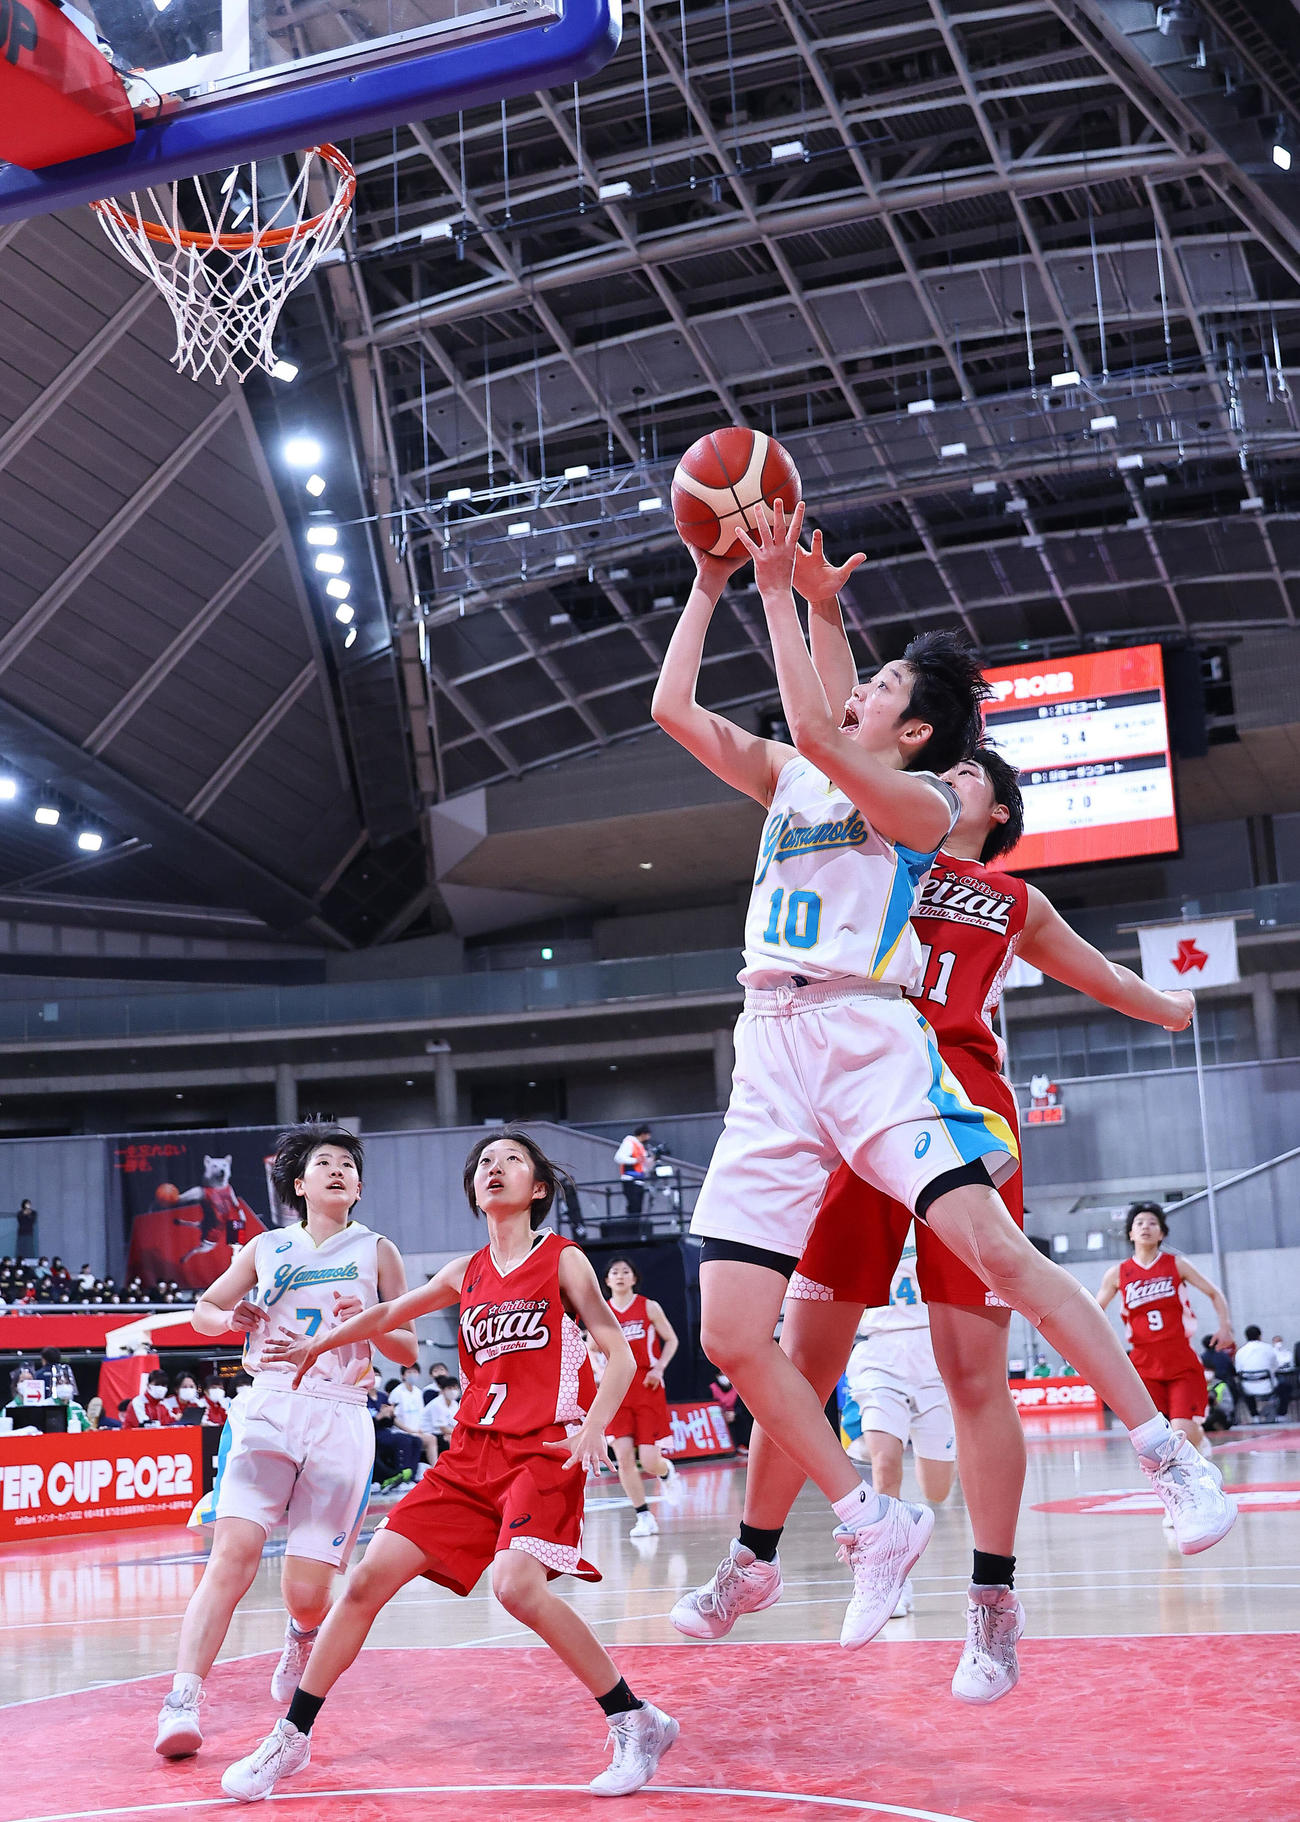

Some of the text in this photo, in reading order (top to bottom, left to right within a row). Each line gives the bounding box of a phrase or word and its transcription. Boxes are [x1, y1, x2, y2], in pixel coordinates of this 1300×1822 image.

[1014, 672, 1074, 699] 2022
[755, 809, 868, 886] Yamanote
[919, 873, 1011, 920] eizai
[959, 876, 1002, 899] Chiba
[763, 887, 822, 950] 10
[953, 912, 990, 927] Fuzoku
[903, 944, 957, 1006] 11
[263, 1261, 359, 1307] Yamanote
[296, 1307, 322, 1337] 7
[460, 1303, 546, 1353] Keizai
[498, 1300, 536, 1314] Chiba
[1147, 1309, 1164, 1331] 9
[478, 1383, 507, 1425] 7
[1046, 1385, 1097, 1404] 2022
[0, 1464, 44, 1511] ER
[47, 1459, 113, 1506] CUP
[115, 1453, 193, 1501] 2022
